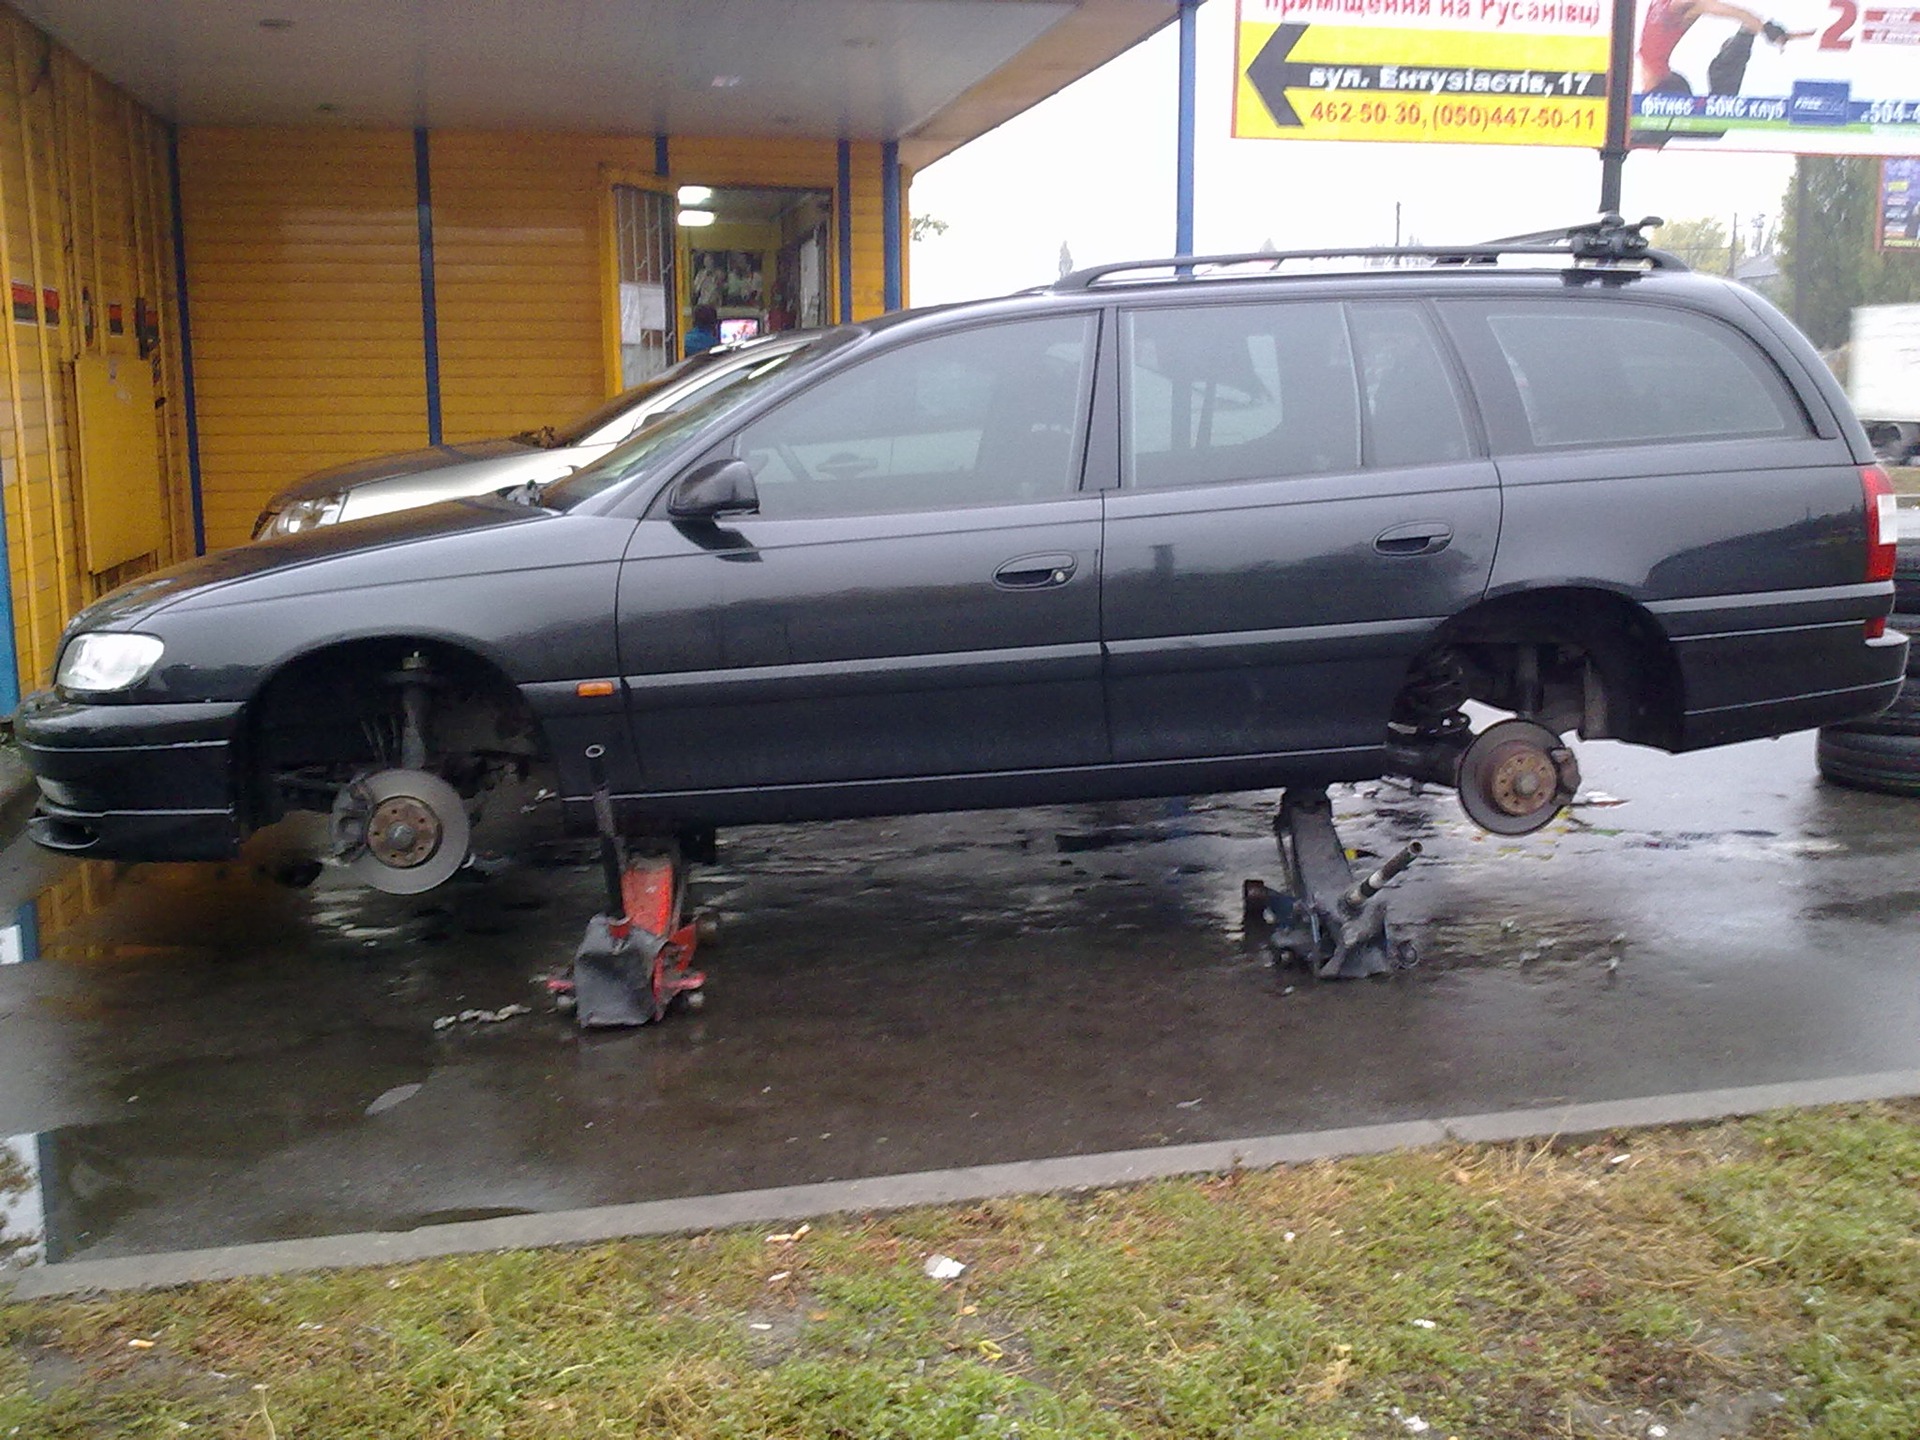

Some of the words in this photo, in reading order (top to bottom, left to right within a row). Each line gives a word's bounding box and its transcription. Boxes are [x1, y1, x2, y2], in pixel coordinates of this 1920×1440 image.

[1440, 0, 1470, 17] на
[1819, 0, 1858, 50] 2
[1308, 66, 1370, 92] вул.
